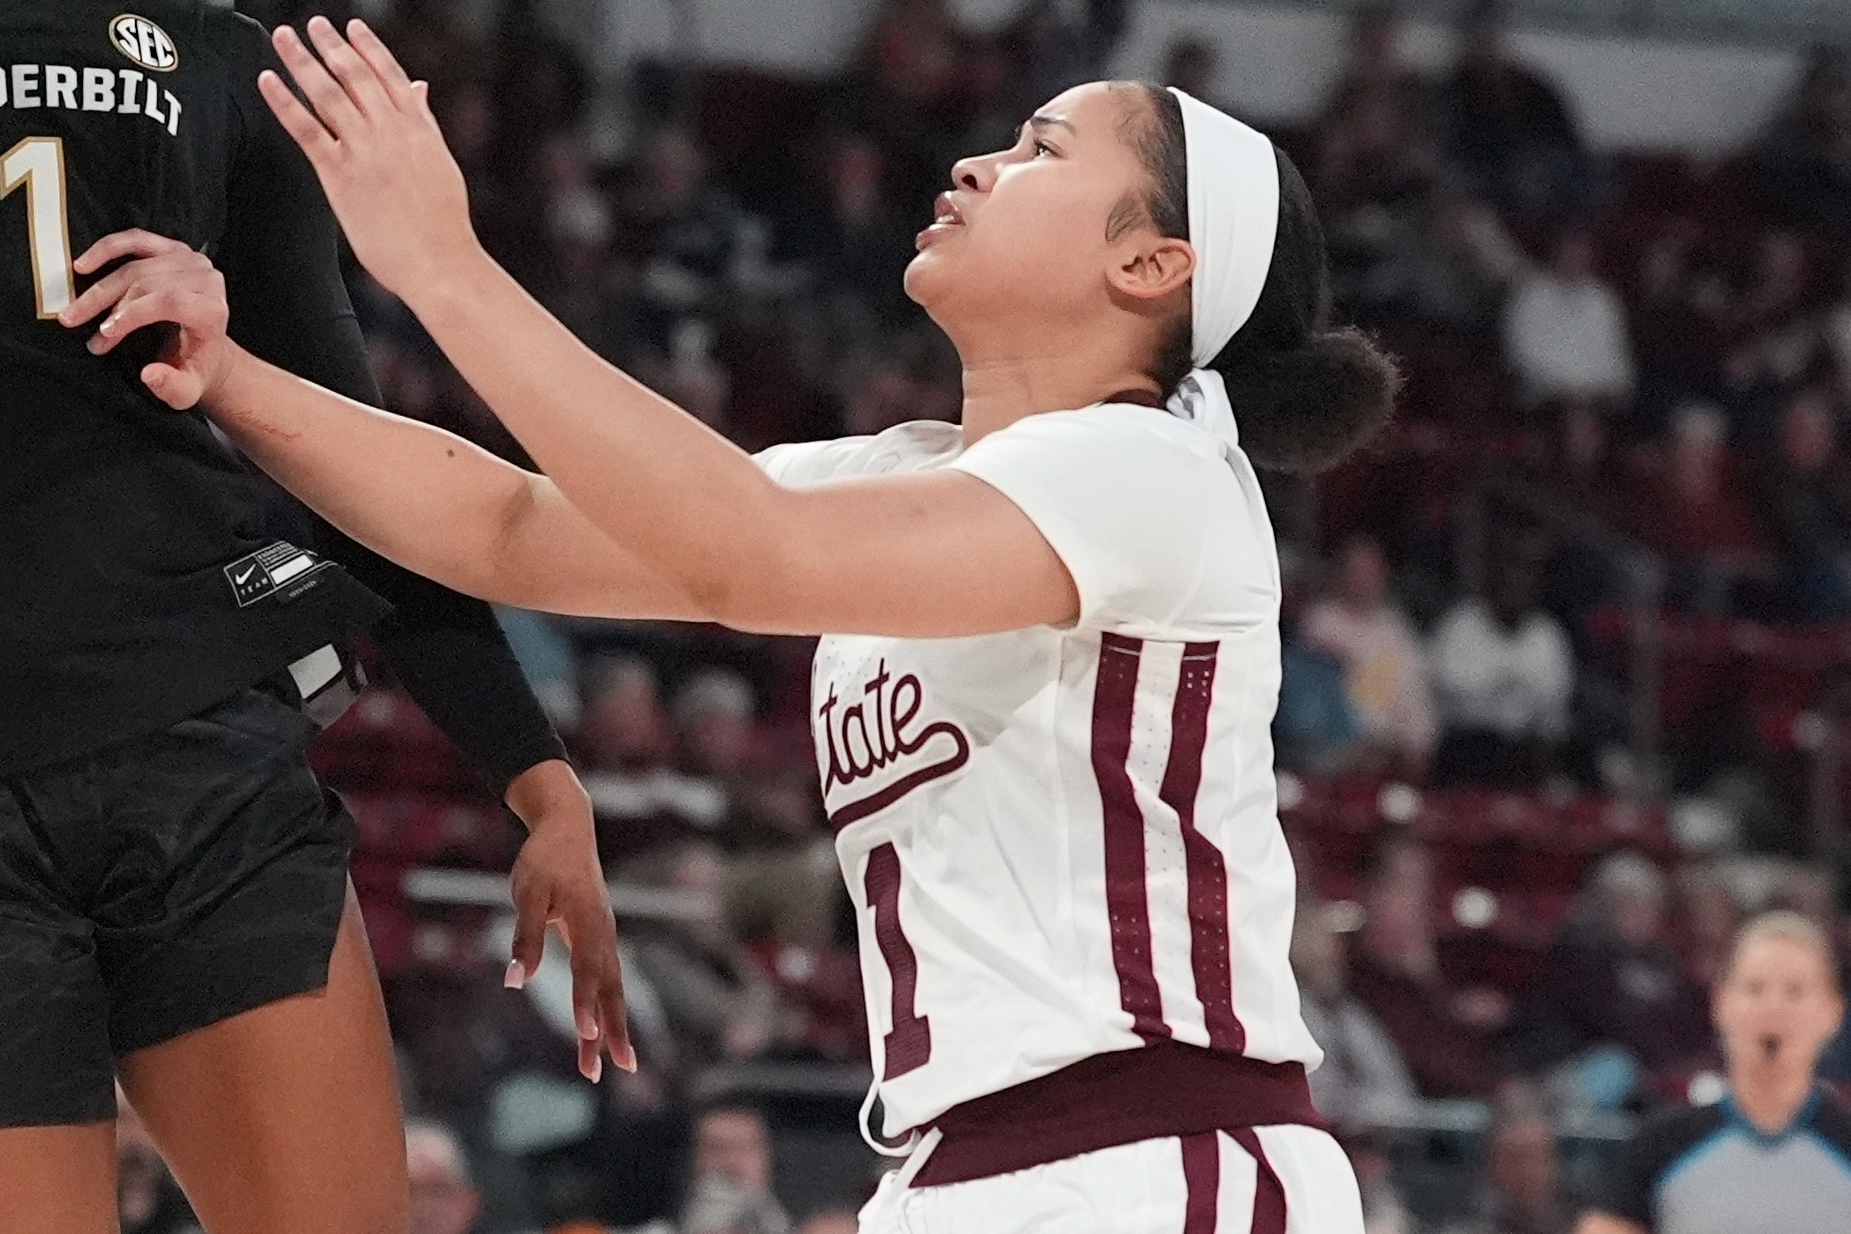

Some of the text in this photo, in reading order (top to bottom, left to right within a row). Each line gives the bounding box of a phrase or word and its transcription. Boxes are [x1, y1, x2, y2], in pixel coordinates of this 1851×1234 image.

[115, 17, 175, 68] SEC
[818, 657, 971, 811] tate
[864, 841, 932, 1084] 1
